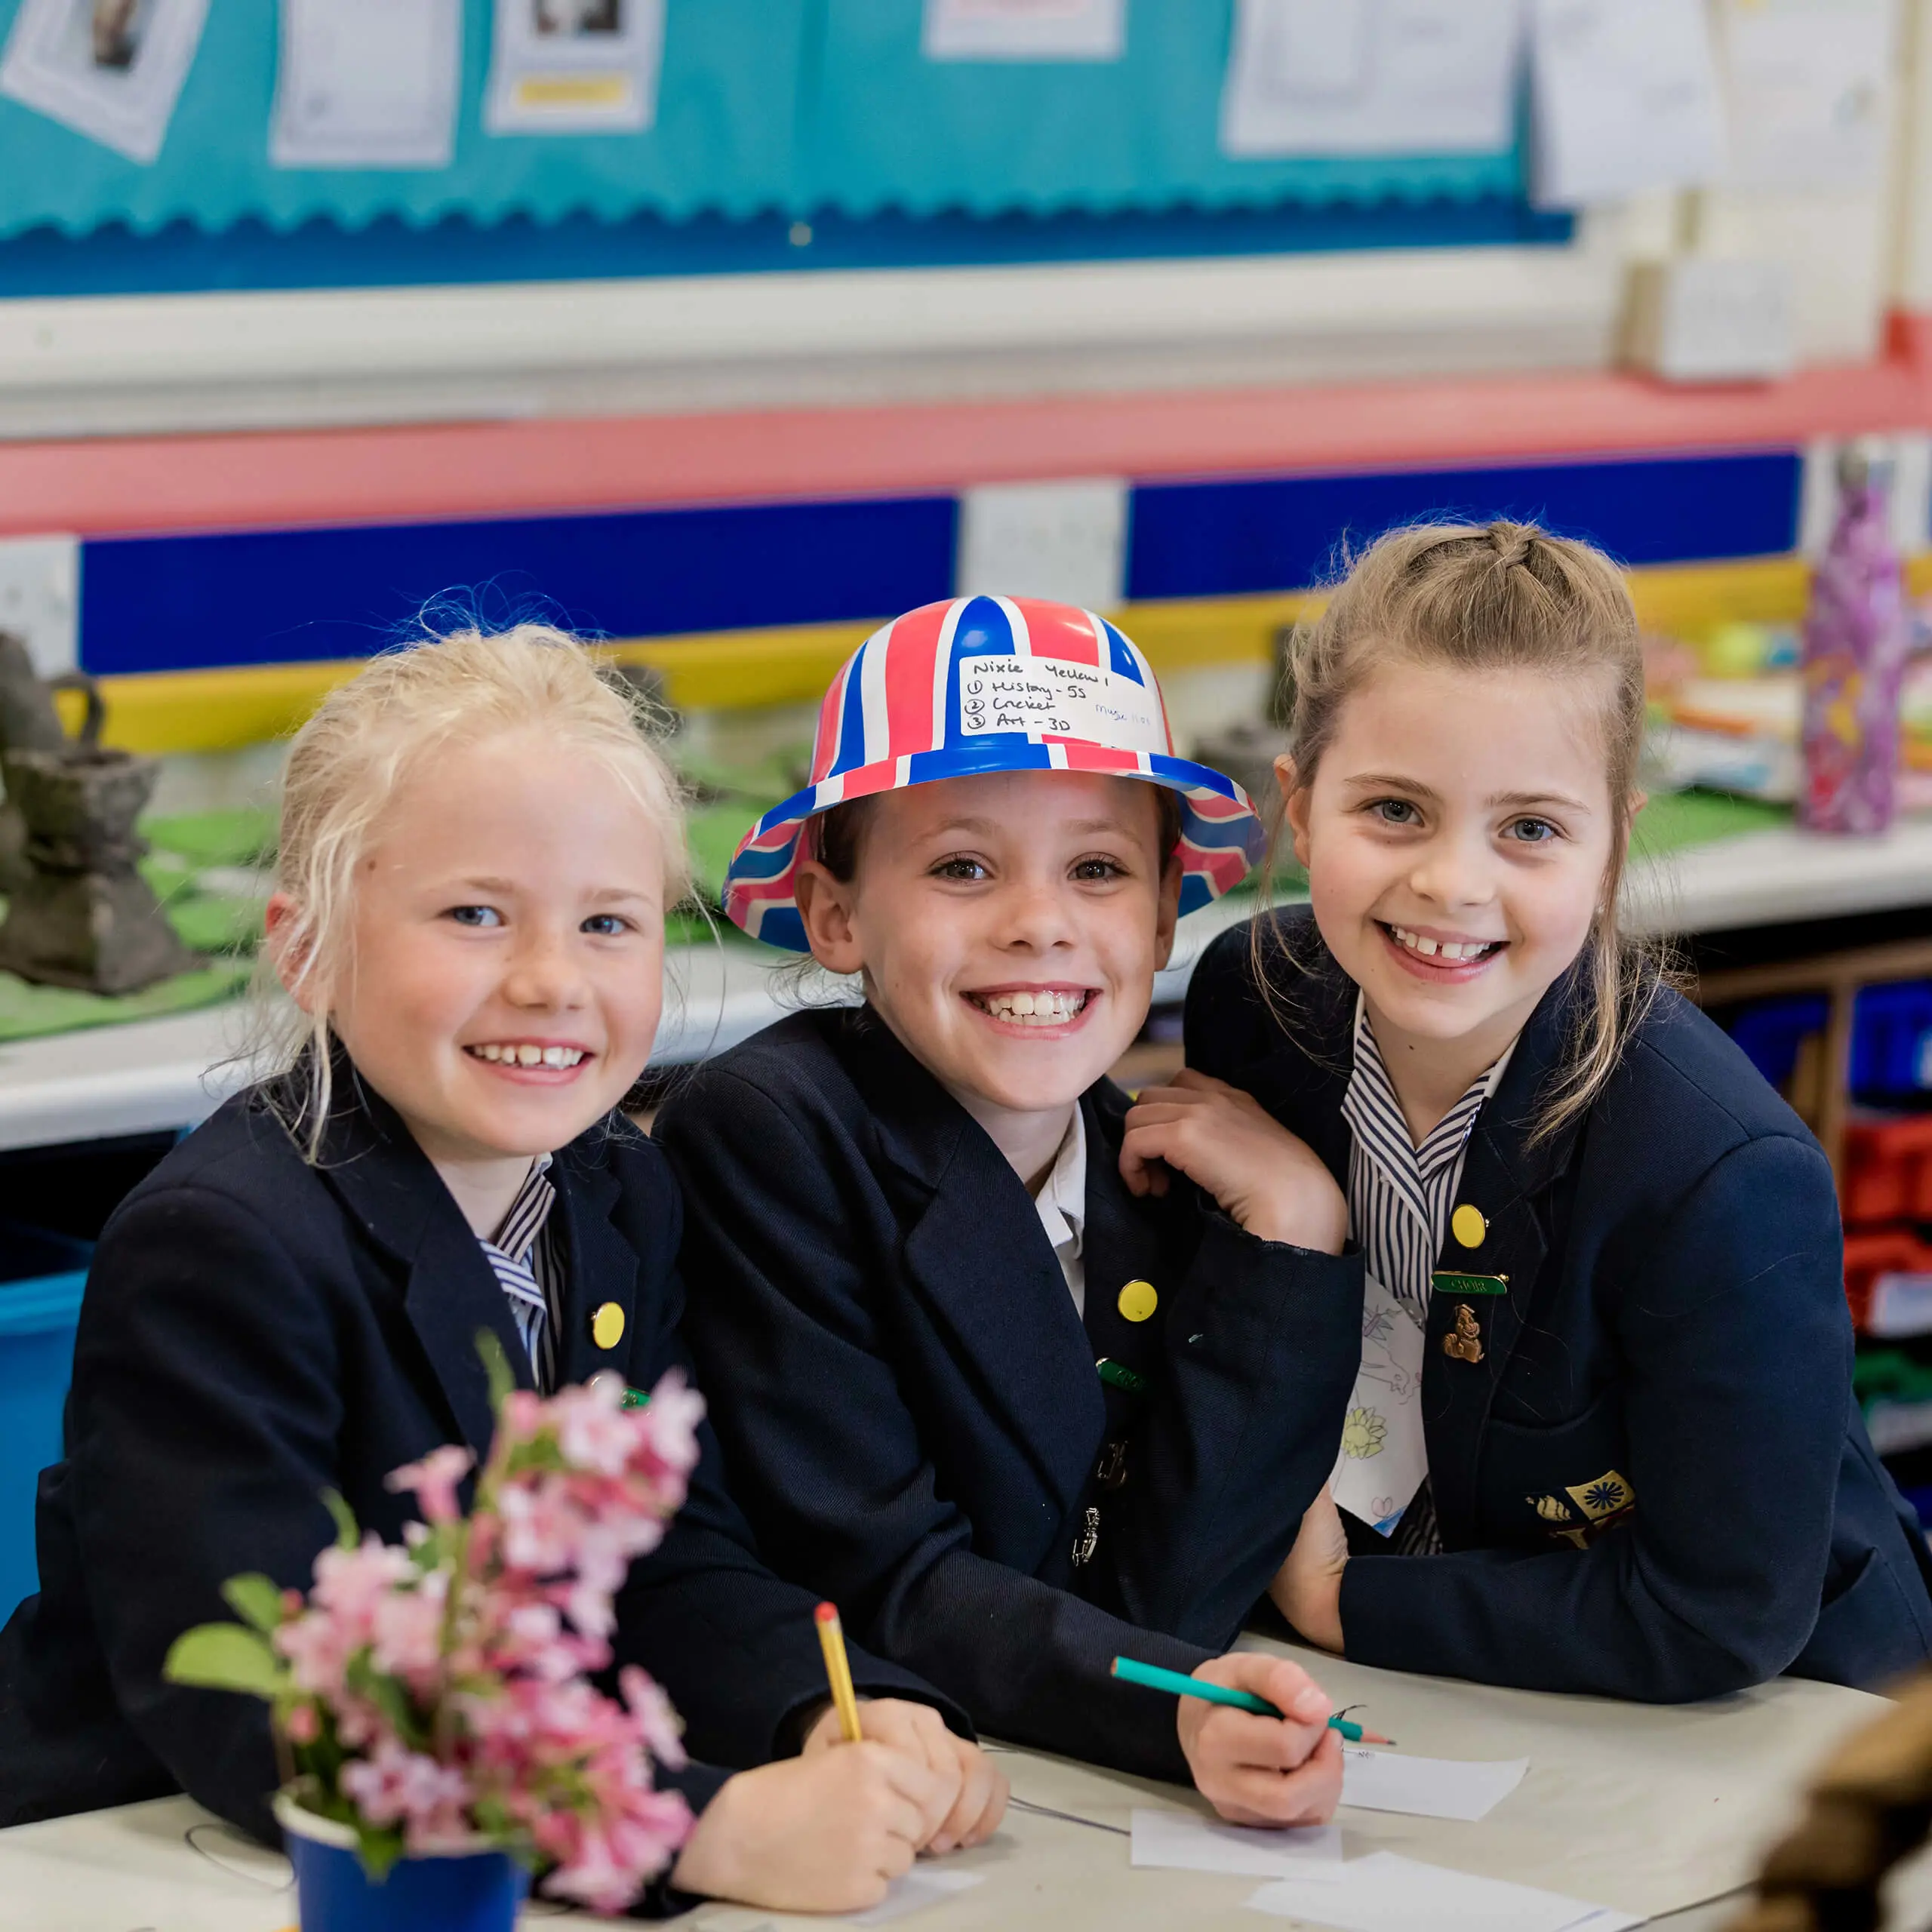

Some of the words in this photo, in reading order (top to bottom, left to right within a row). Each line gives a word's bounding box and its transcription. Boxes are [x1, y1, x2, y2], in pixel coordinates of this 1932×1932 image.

[974, 658, 1023, 675] Nixie
[1044, 664, 1099, 683] Yellow
[992, 681, 1053, 701] History
[992, 696, 1056, 711] Cricket
[996, 712, 1026, 727] Art
[1048, 717, 1071, 731] 3D
